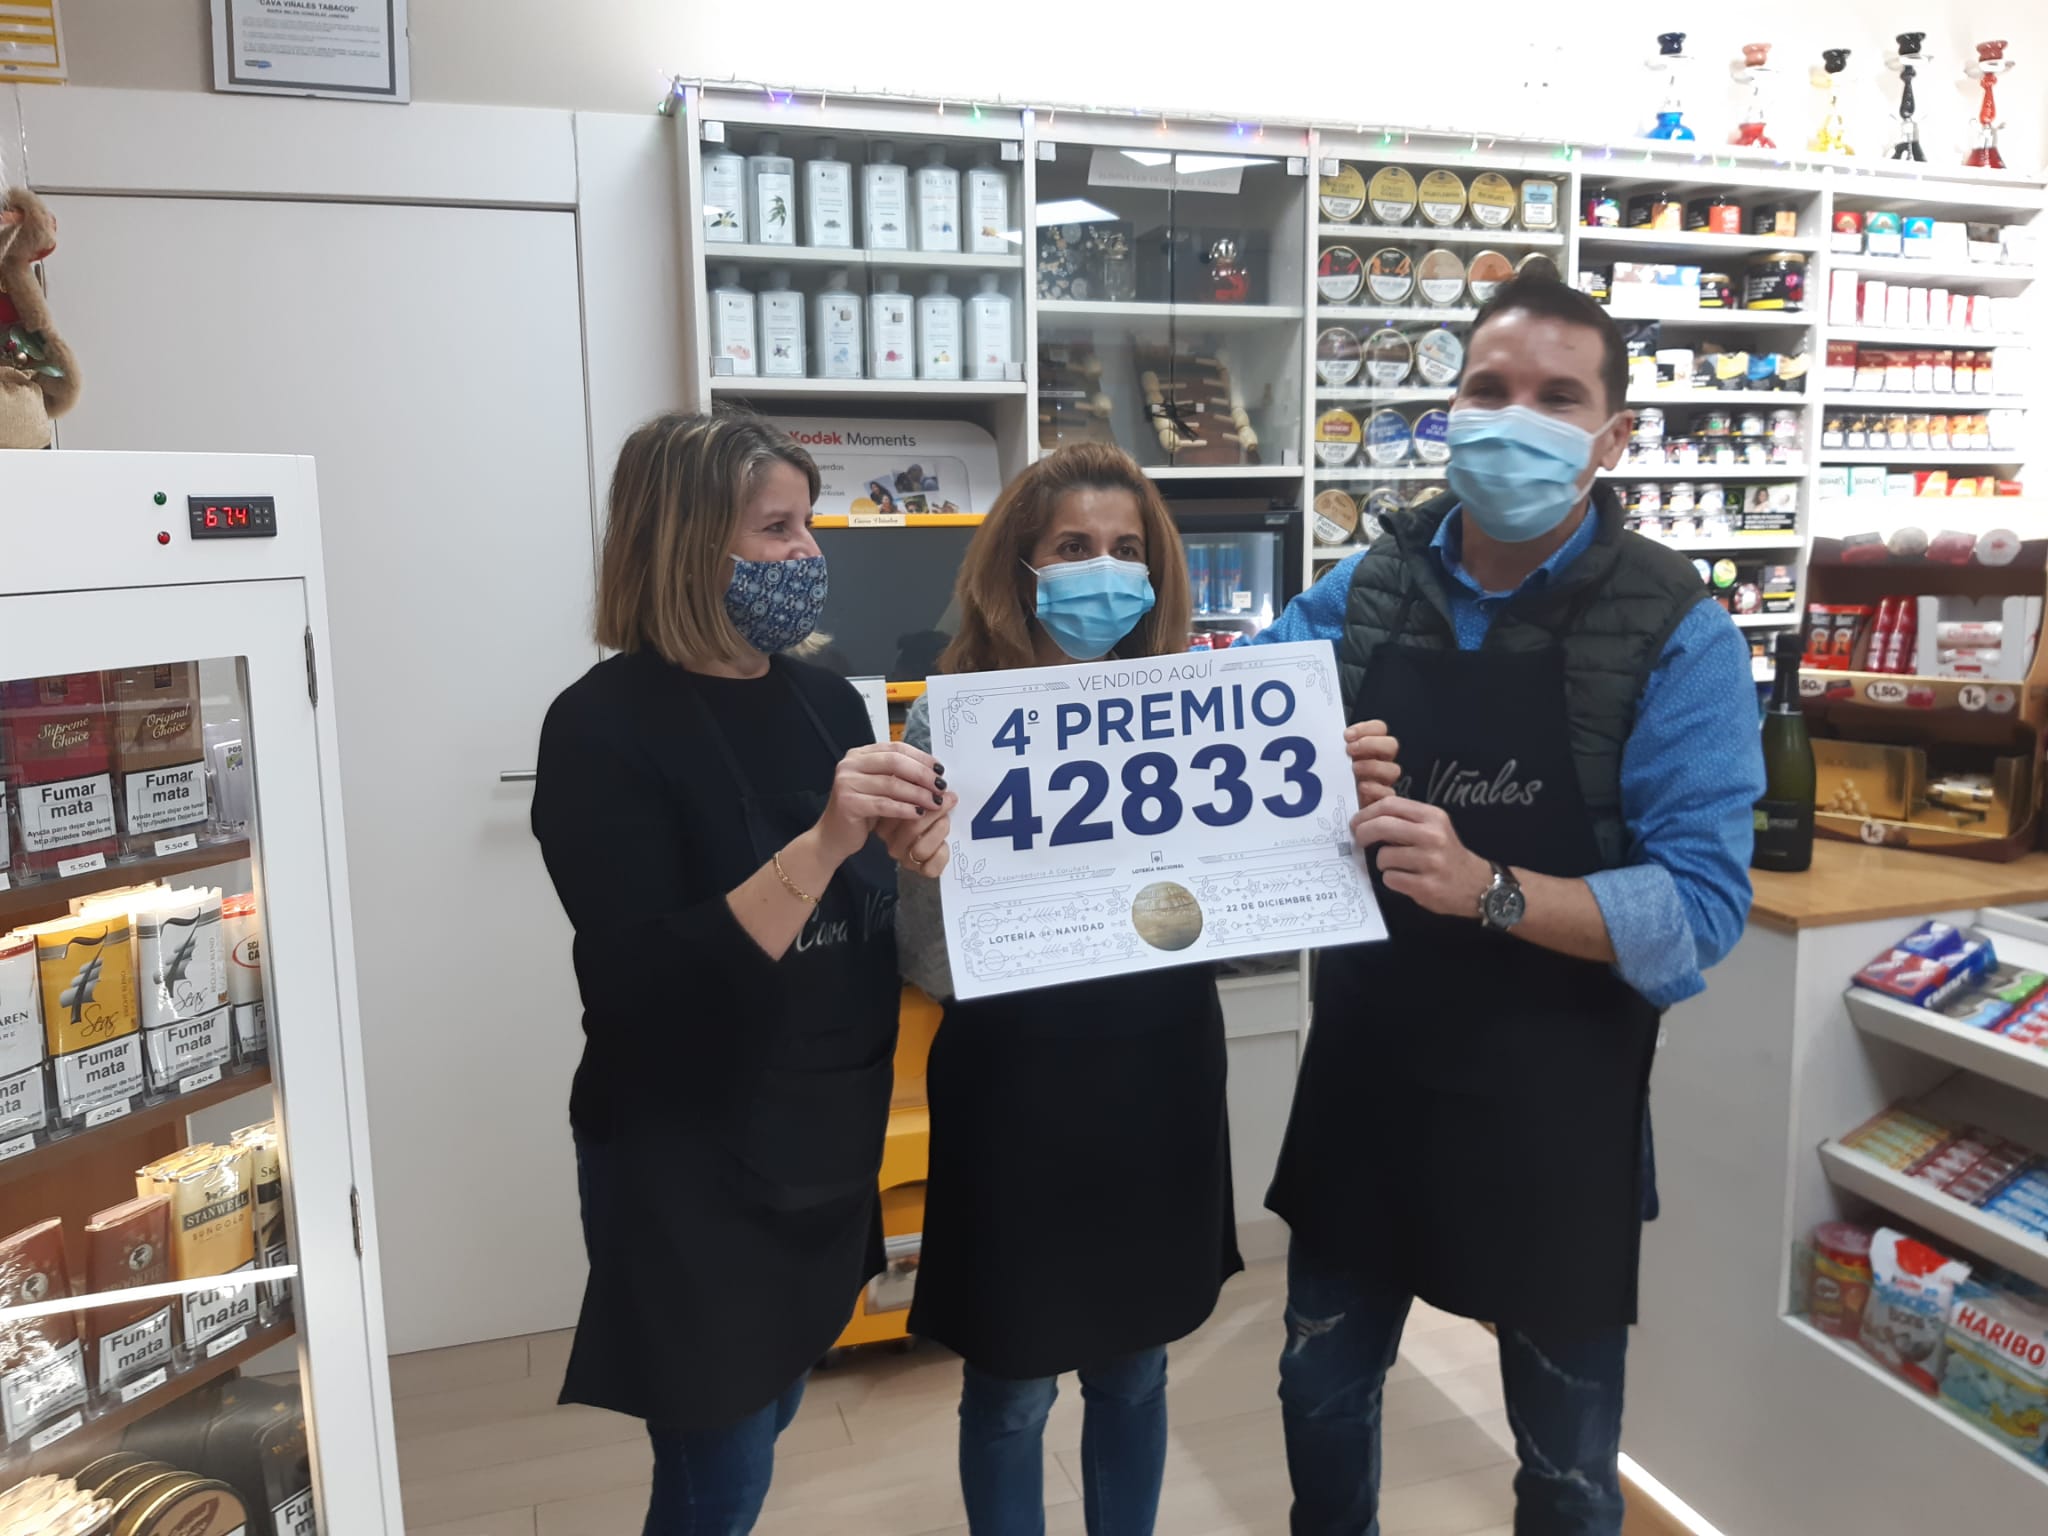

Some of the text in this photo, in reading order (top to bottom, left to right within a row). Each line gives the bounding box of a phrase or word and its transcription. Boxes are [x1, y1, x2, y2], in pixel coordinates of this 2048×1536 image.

[847, 432, 917, 447] Moments
[1078, 660, 1213, 691] VENDIDO AQUÍ
[146, 703, 190, 727] Original
[992, 680, 1296, 756] 4º PREMIO
[38, 718, 89, 739] Supreme
[52, 731, 89, 749] Choice
[152, 722, 187, 739] Choice
[146, 769, 193, 788] Fumar
[1426, 759, 1543, 807] Viñales
[42, 783, 96, 803] Fumar
[153, 785, 190, 803] mata
[971, 736, 1322, 851] 42833
[51, 799, 93, 819] mata
[164, 840, 189, 852] 5.50€
[70, 860, 97, 871] 5.50€
[1226, 891, 1338, 913] 22 DE DICIEMBRE 2021
[989, 932, 1036, 945] LOTERÍA
[1056, 921, 1105, 936] NAVIDAD
[168, 1016, 216, 1042] Fumar
[78, 1042, 130, 1069] Fumar
[175, 1034, 212, 1056] mata
[86, 1061, 125, 1084] mata
[186, 1192, 248, 1228] STANWELL
[193, 1213, 245, 1241] SUNGOLD
[196, 1298, 250, 1333] mata
[1957, 1306, 2046, 1366] HARIBO
[118, 1337, 163, 1369] mata
